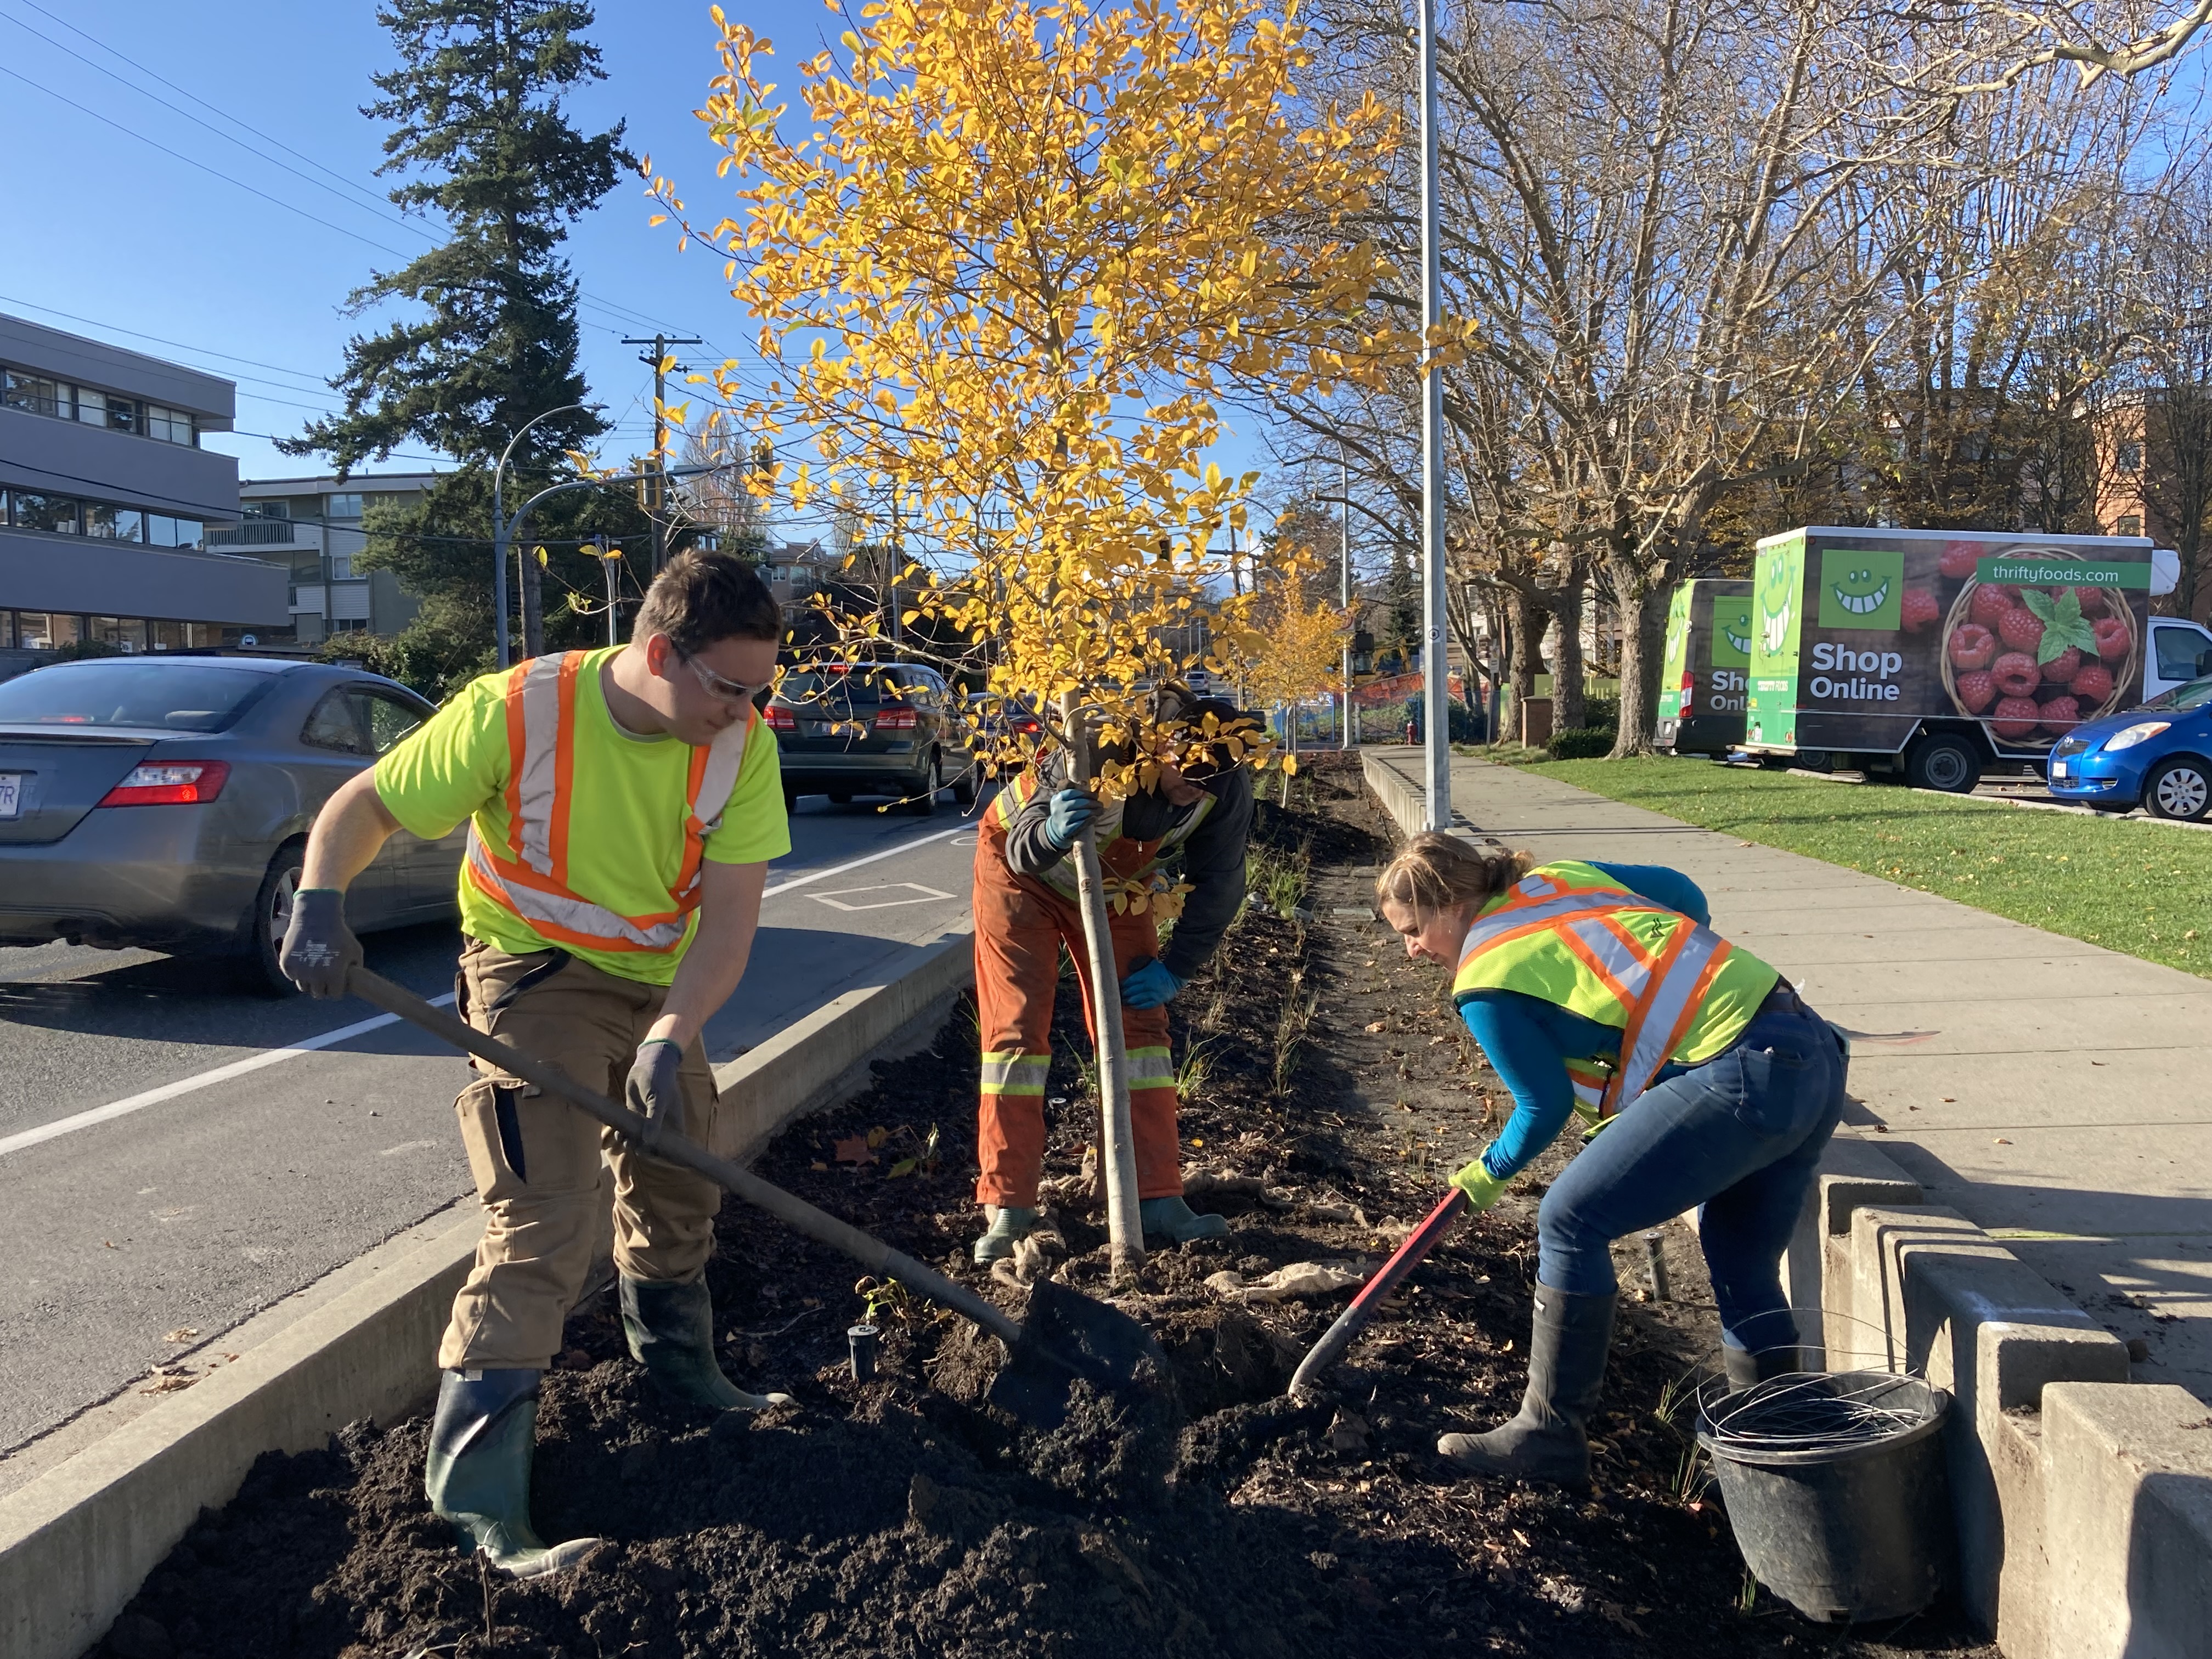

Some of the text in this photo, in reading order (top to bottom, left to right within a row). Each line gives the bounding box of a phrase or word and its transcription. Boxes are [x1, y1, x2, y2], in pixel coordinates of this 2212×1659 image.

[1993, 566, 2118, 582] thriftyfoods.com
[1811, 642, 1902, 680] Shop
[1775, 680, 1788, 691] FOODS
[1810, 676, 1900, 701] Online
